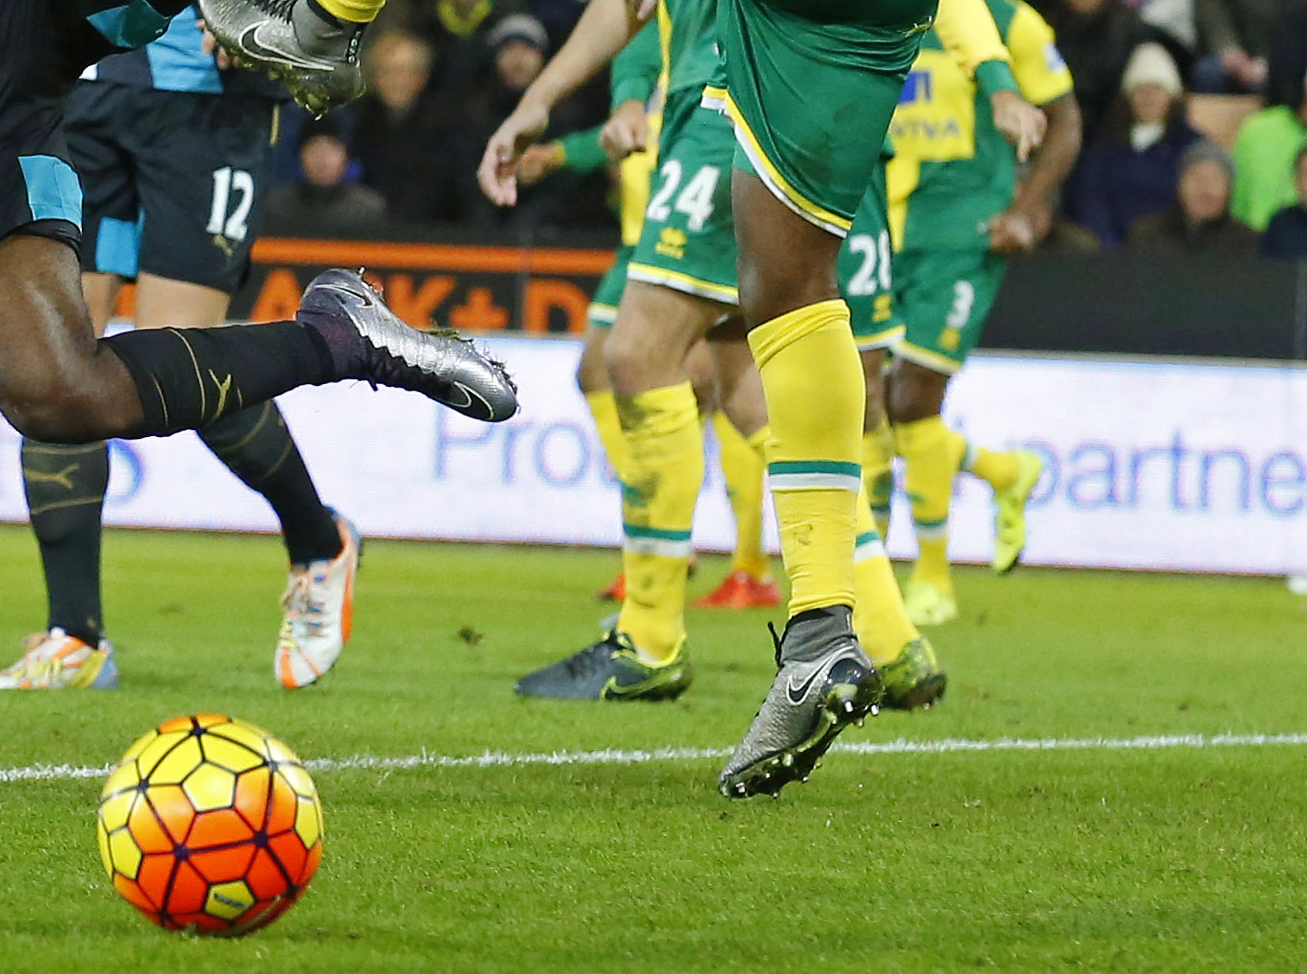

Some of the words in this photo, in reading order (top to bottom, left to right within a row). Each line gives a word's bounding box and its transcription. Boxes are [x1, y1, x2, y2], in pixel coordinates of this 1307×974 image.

[205, 166, 254, 243] 12
[646, 158, 721, 233] 24
[946, 279, 975, 327] 3
